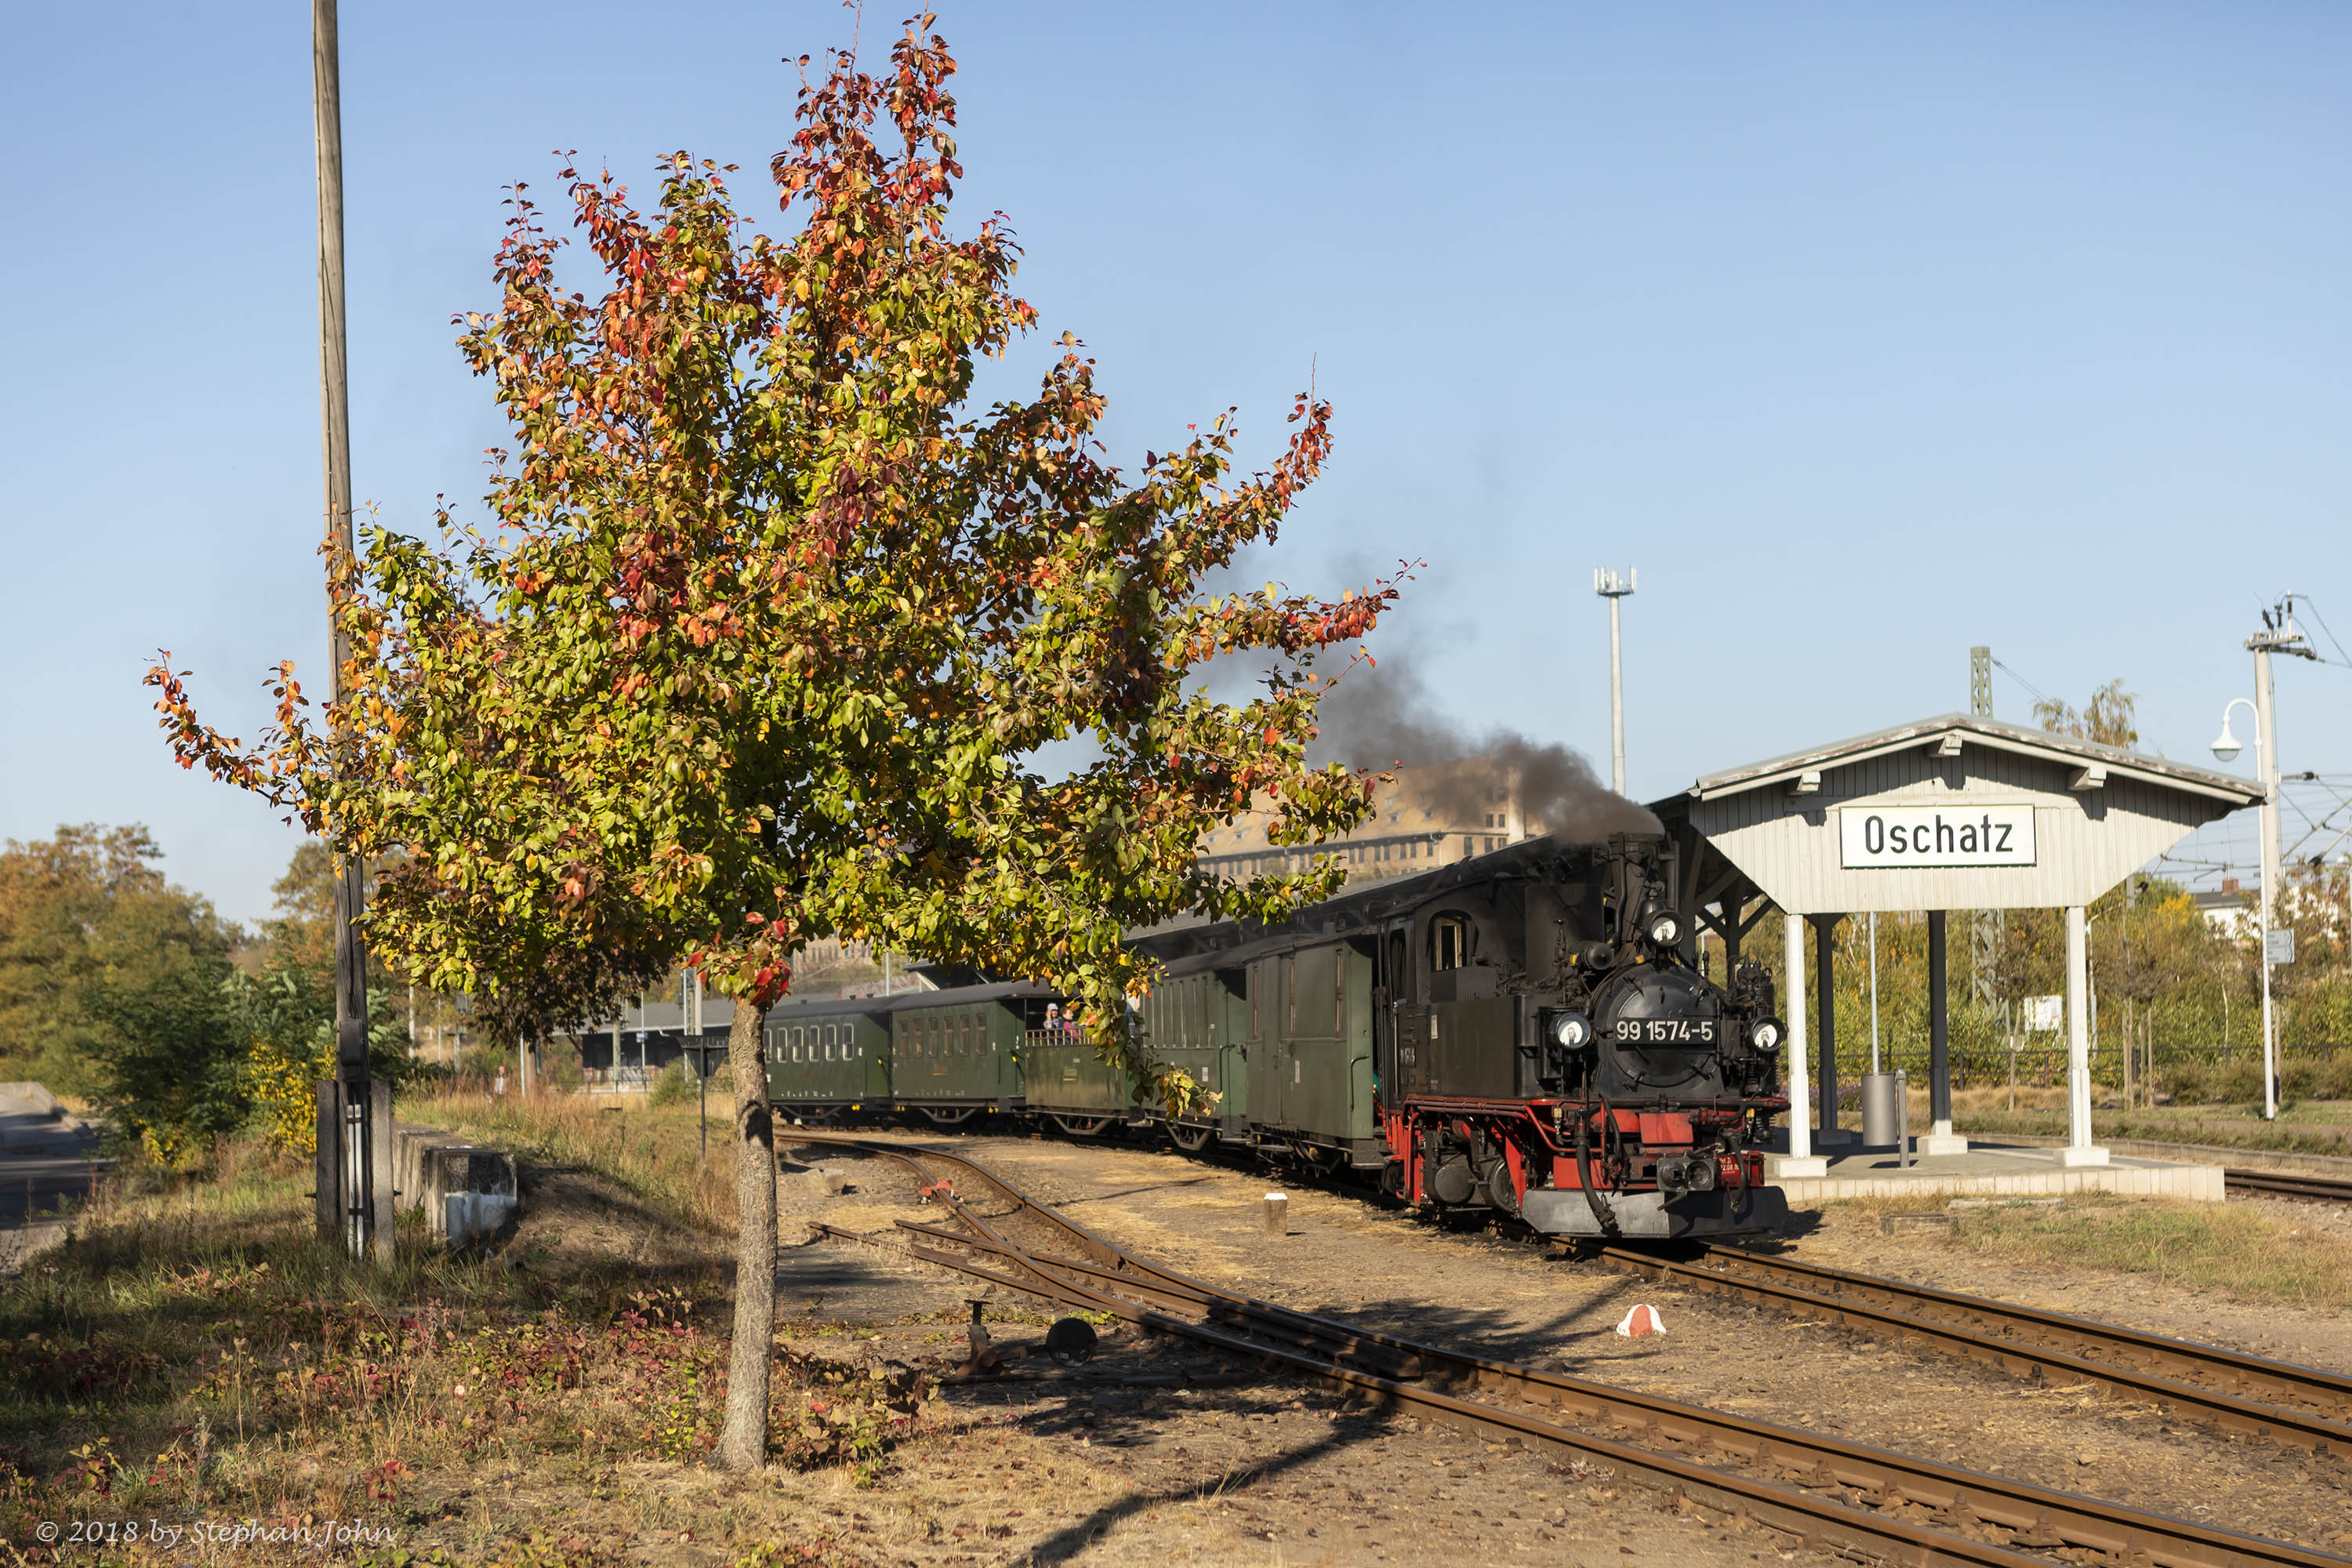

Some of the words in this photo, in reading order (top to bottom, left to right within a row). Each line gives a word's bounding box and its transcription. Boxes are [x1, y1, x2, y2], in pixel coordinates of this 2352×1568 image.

[1864, 814, 2013, 854] Oschatz
[1617, 1021, 1641, 1040] 99
[1646, 1021, 1713, 1041] 1574-5
